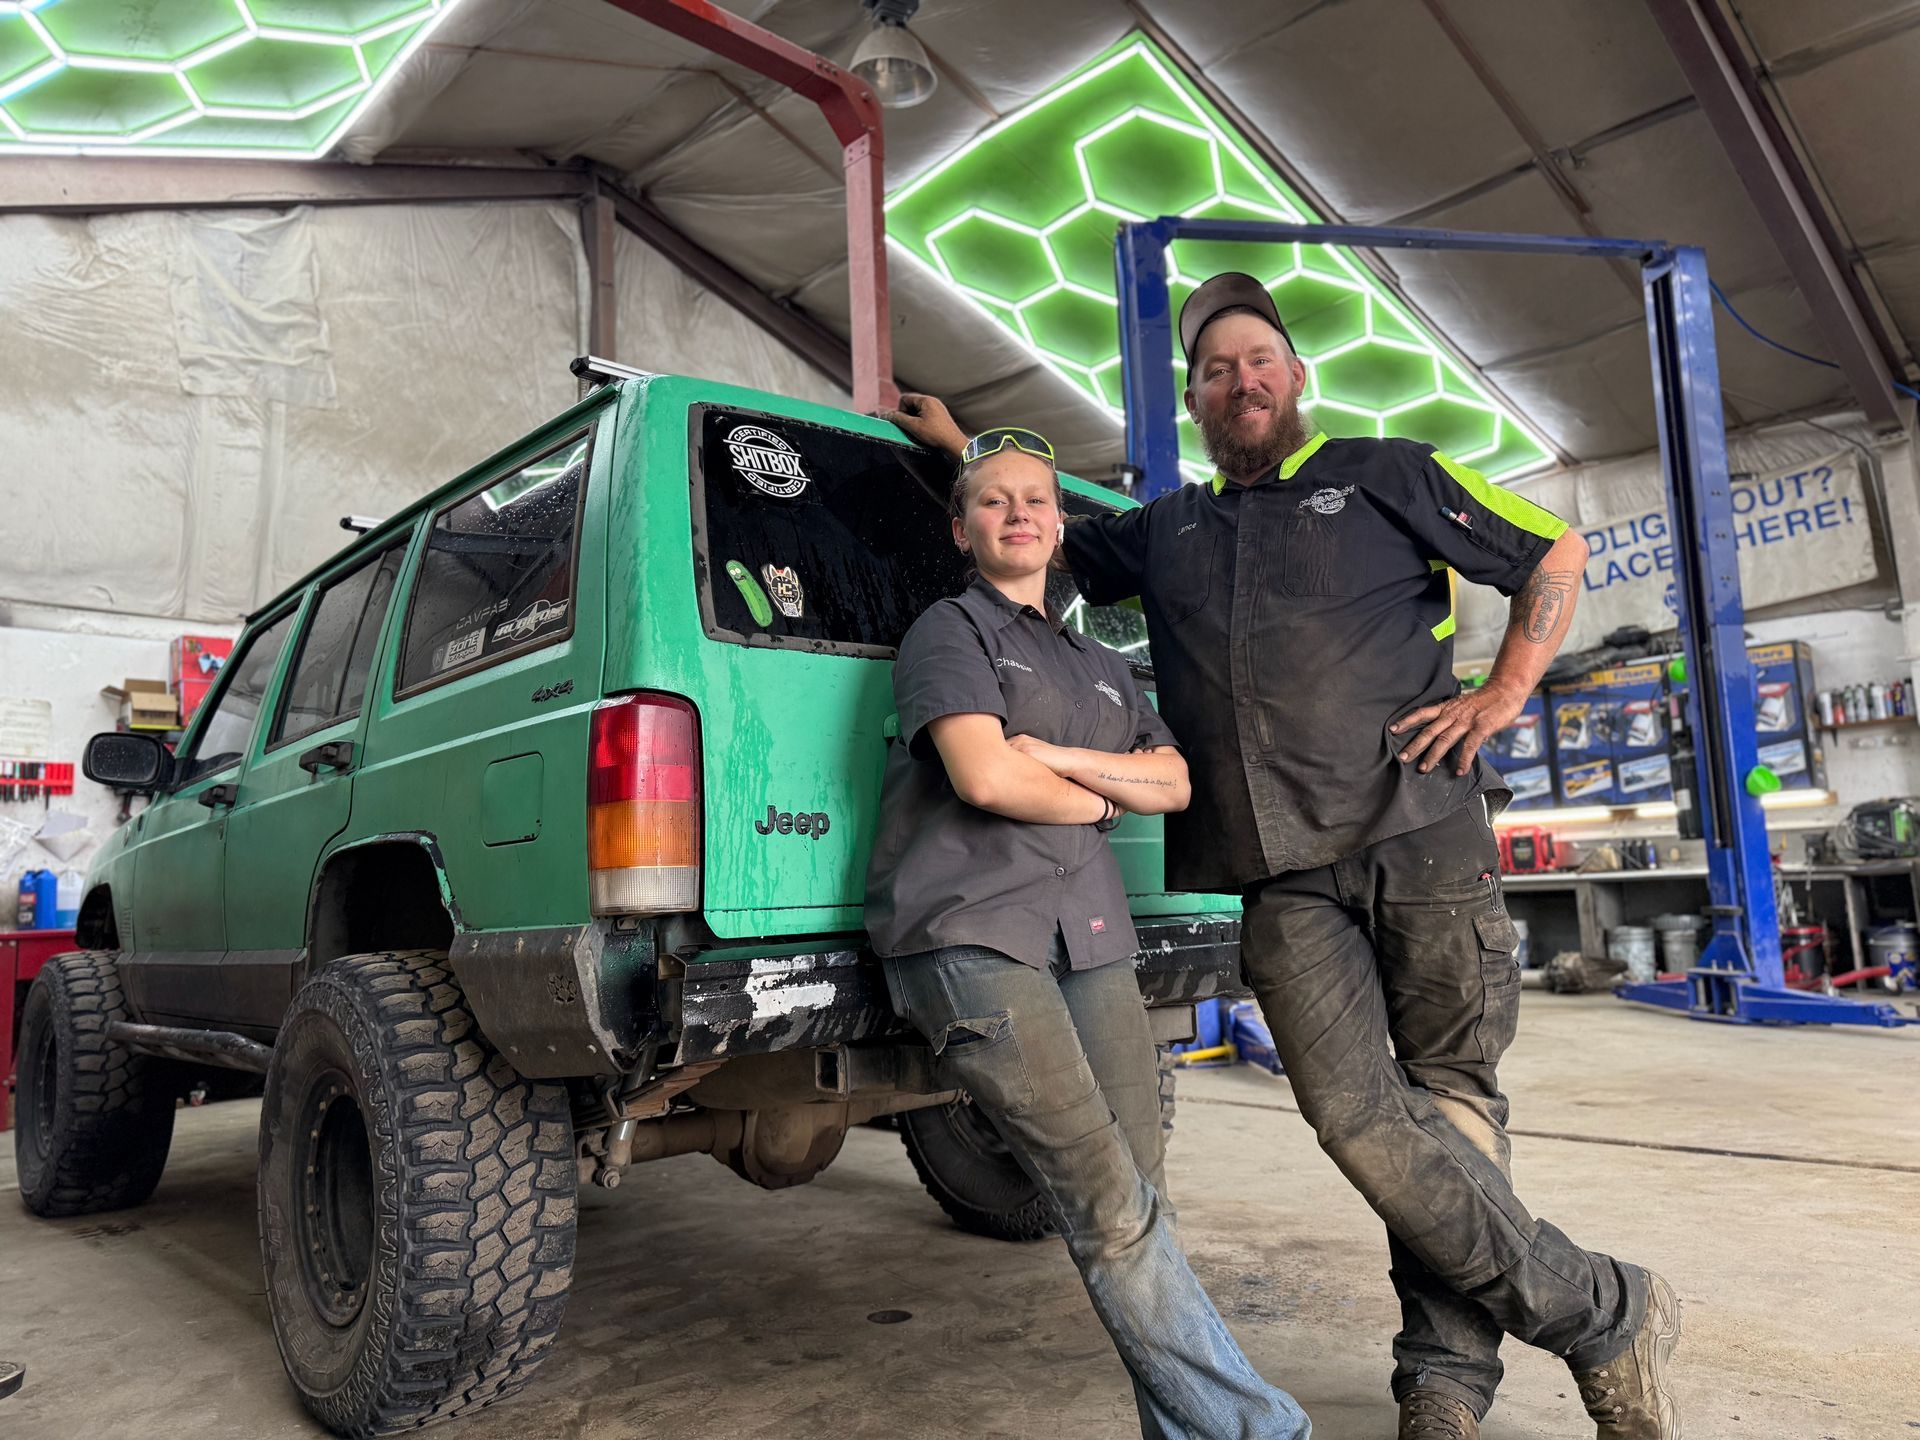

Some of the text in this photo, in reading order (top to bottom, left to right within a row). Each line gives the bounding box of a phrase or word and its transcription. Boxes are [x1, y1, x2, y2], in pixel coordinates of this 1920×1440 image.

[733, 428, 788, 451] CERTIFIED
[728, 443, 807, 478] SHITBOX
[747, 472, 802, 495] CERTIFIED
[1730, 465, 1834, 515] OUT?
[754, 804, 831, 841] Jeep
